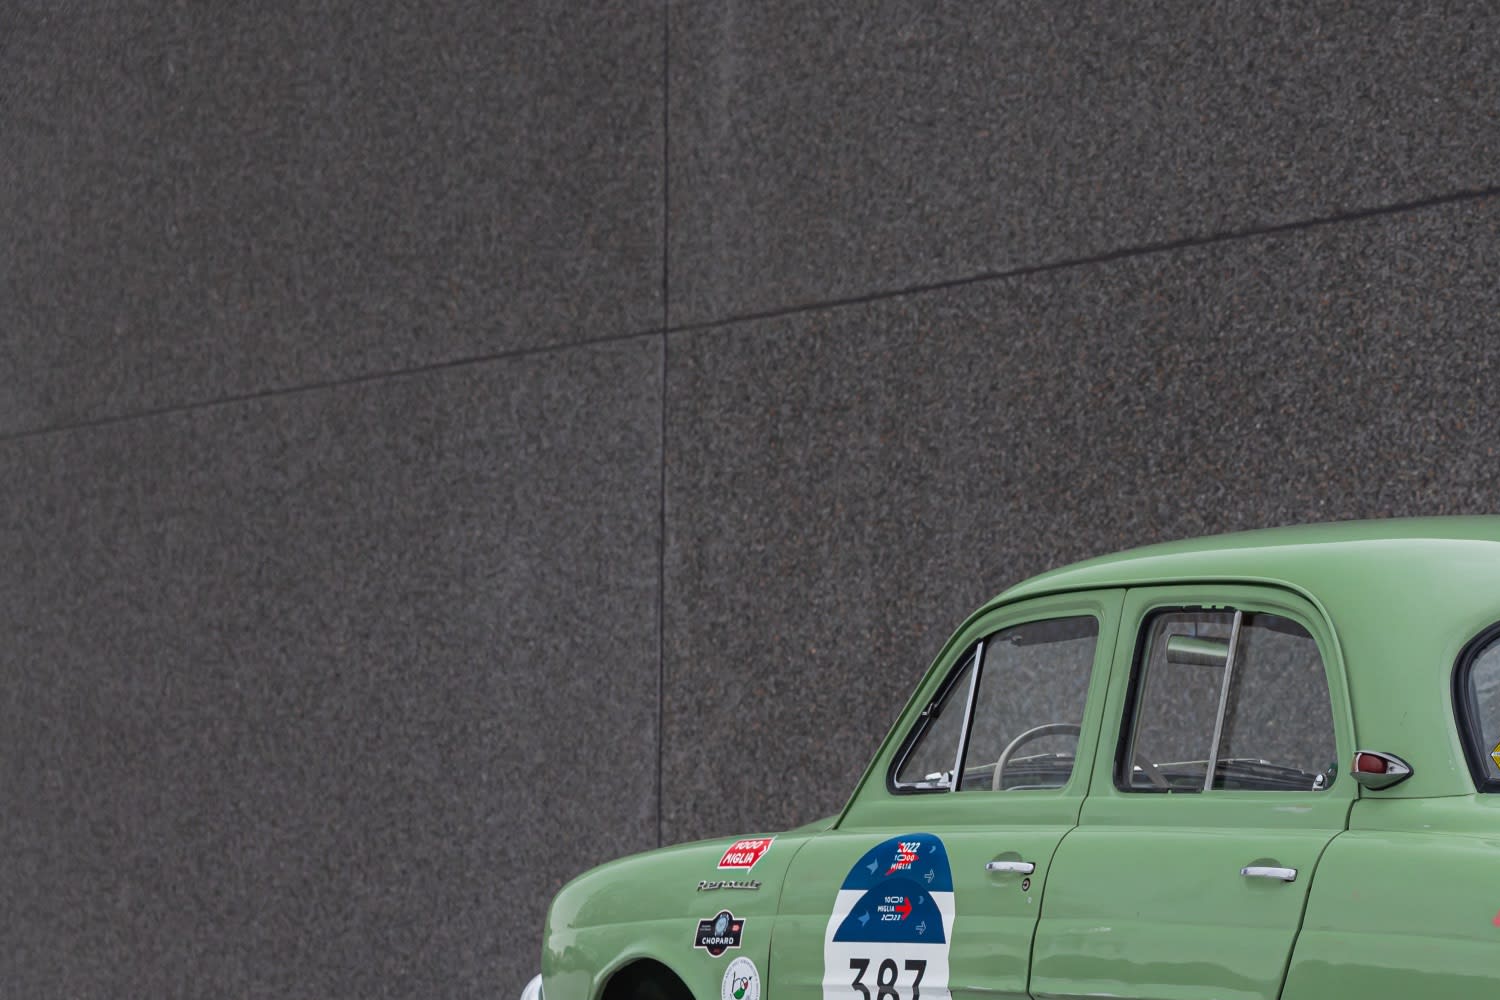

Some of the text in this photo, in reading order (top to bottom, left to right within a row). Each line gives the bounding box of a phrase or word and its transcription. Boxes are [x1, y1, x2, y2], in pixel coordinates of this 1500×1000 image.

[897, 842, 920, 853] 2022
[722, 852, 755, 864] MIGLIA
[884, 896, 904, 904] 1000
[877, 905, 895, 913] MIGLIA
[701, 937, 734, 945] CHOPARD
